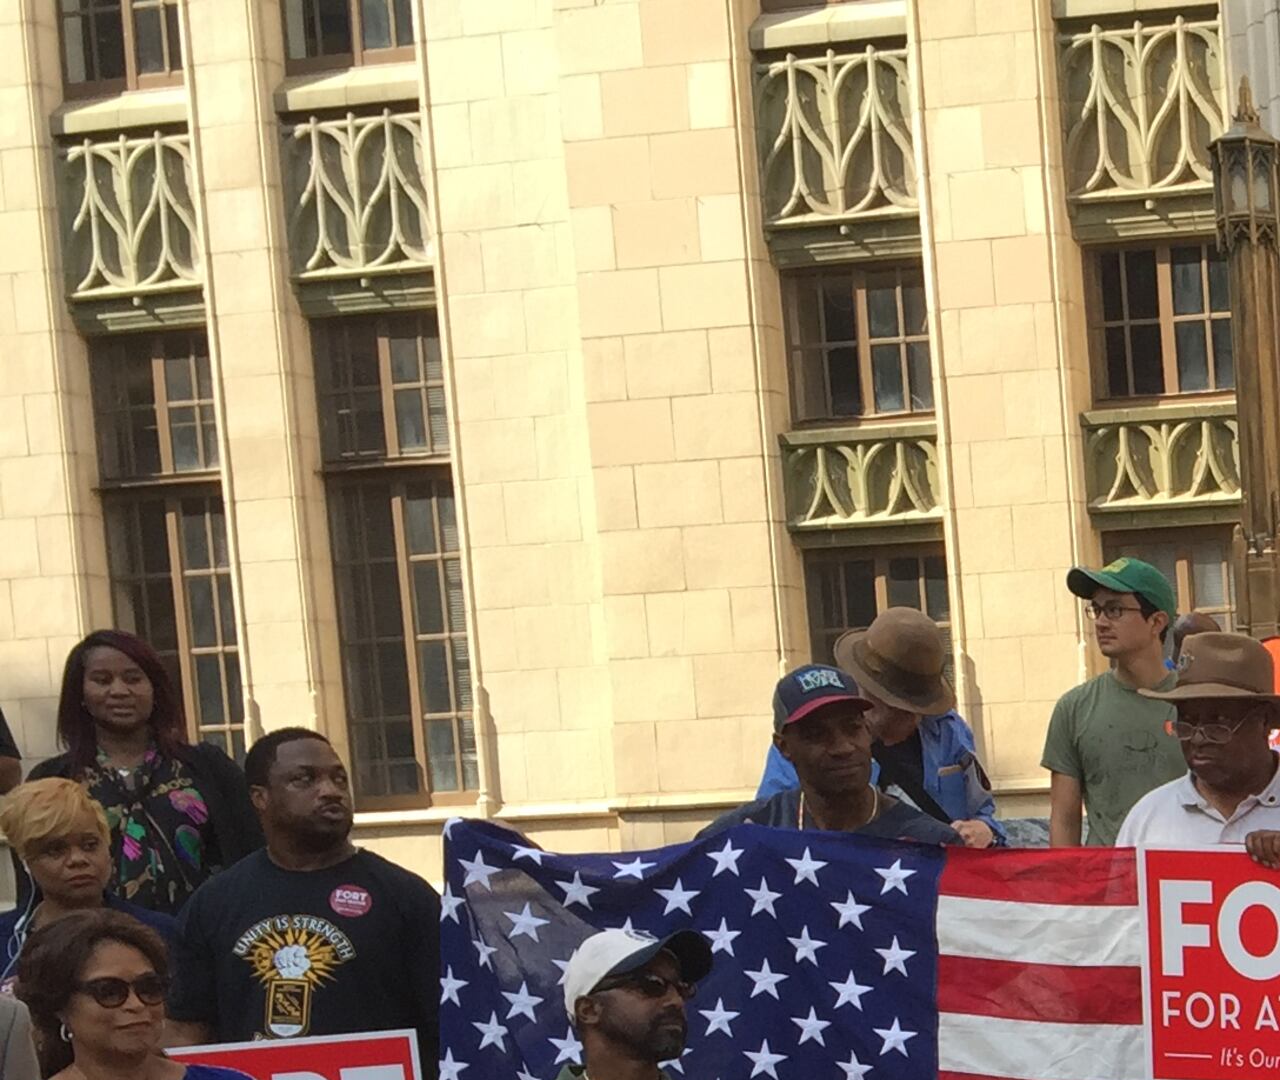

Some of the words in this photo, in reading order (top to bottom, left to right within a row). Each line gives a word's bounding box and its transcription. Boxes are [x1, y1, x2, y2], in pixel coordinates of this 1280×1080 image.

[335, 888, 368, 902] FORT
[233, 920, 273, 954] UNITY
[276, 916, 289, 930] IS
[293, 916, 354, 960] STRENGTH
[1161, 990, 1241, 1031] FOR
[1220, 1047, 1244, 1068] It's
